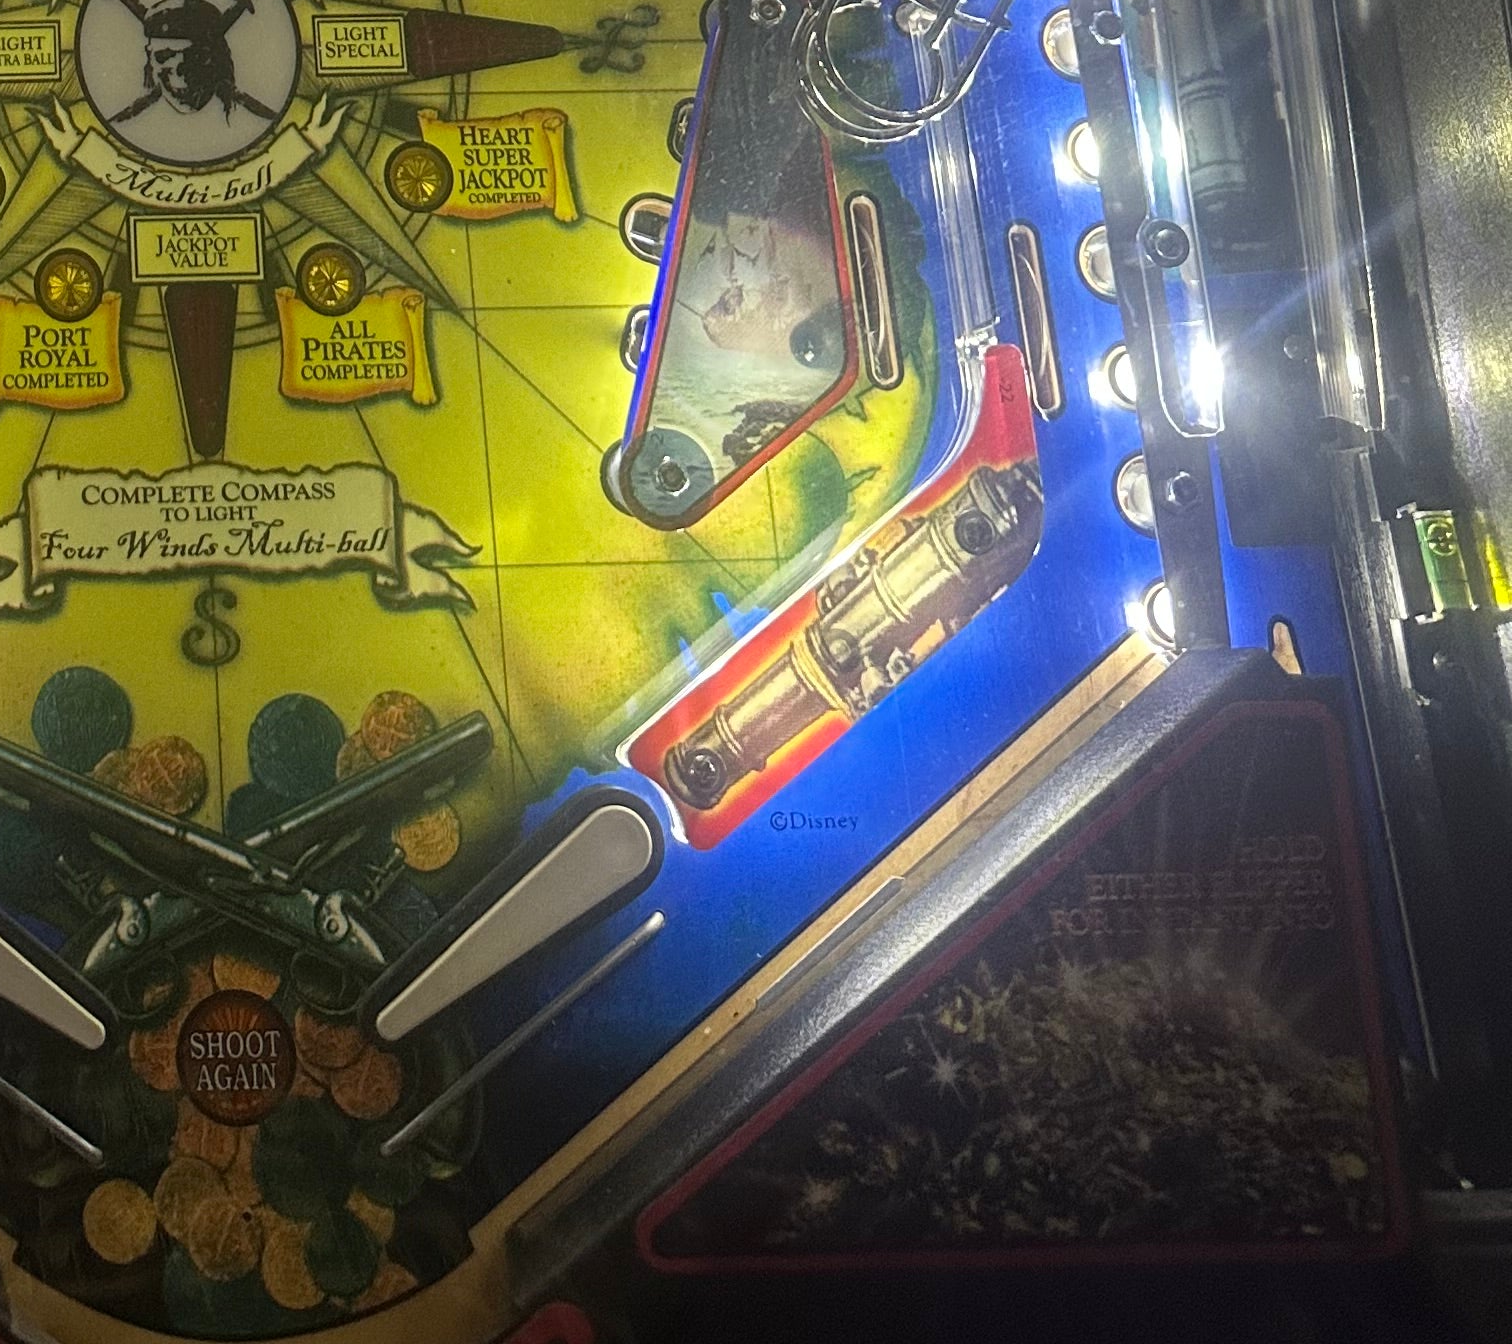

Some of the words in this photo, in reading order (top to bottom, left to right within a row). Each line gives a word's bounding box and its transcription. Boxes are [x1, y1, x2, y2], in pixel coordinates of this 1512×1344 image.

[333, 26, 388, 42] LIGHT
[24, 51, 56, 66] BALL
[325, 41, 399, 59] SPECIAL
[457, 126, 534, 146] HEART
[463, 148, 534, 166] SUPER
[106, 161, 273, 204] Multi-ball
[458, 169, 549, 193] JACKPOT
[468, 191, 542, 204] COMPLETED
[171, 222, 218, 236] MAX
[156, 235, 240, 256] JACKPOT
[169, 252, 228, 268] VALUE
[23, 325, 92, 348] PORT
[329, 320, 376, 340] ALL
[18, 349, 97, 369] ROYAL
[302, 339, 406, 361] PIRATES
[3, 373, 109, 390] COMPLETED
[301, 364, 408, 380] COMPLETED
[81, 484, 214, 505] COMPLETE
[221, 481, 336, 502] COMPASS
[160, 507, 190, 522] TO
[195, 505, 258, 521] LIGHT
[42, 530, 108, 560] Four
[118, 528, 219, 558] Winds
[224, 520, 391, 557] Multi-ball
[189, 1031, 282, 1059] SHOOT
[195, 1062, 277, 1091] AGAIN
